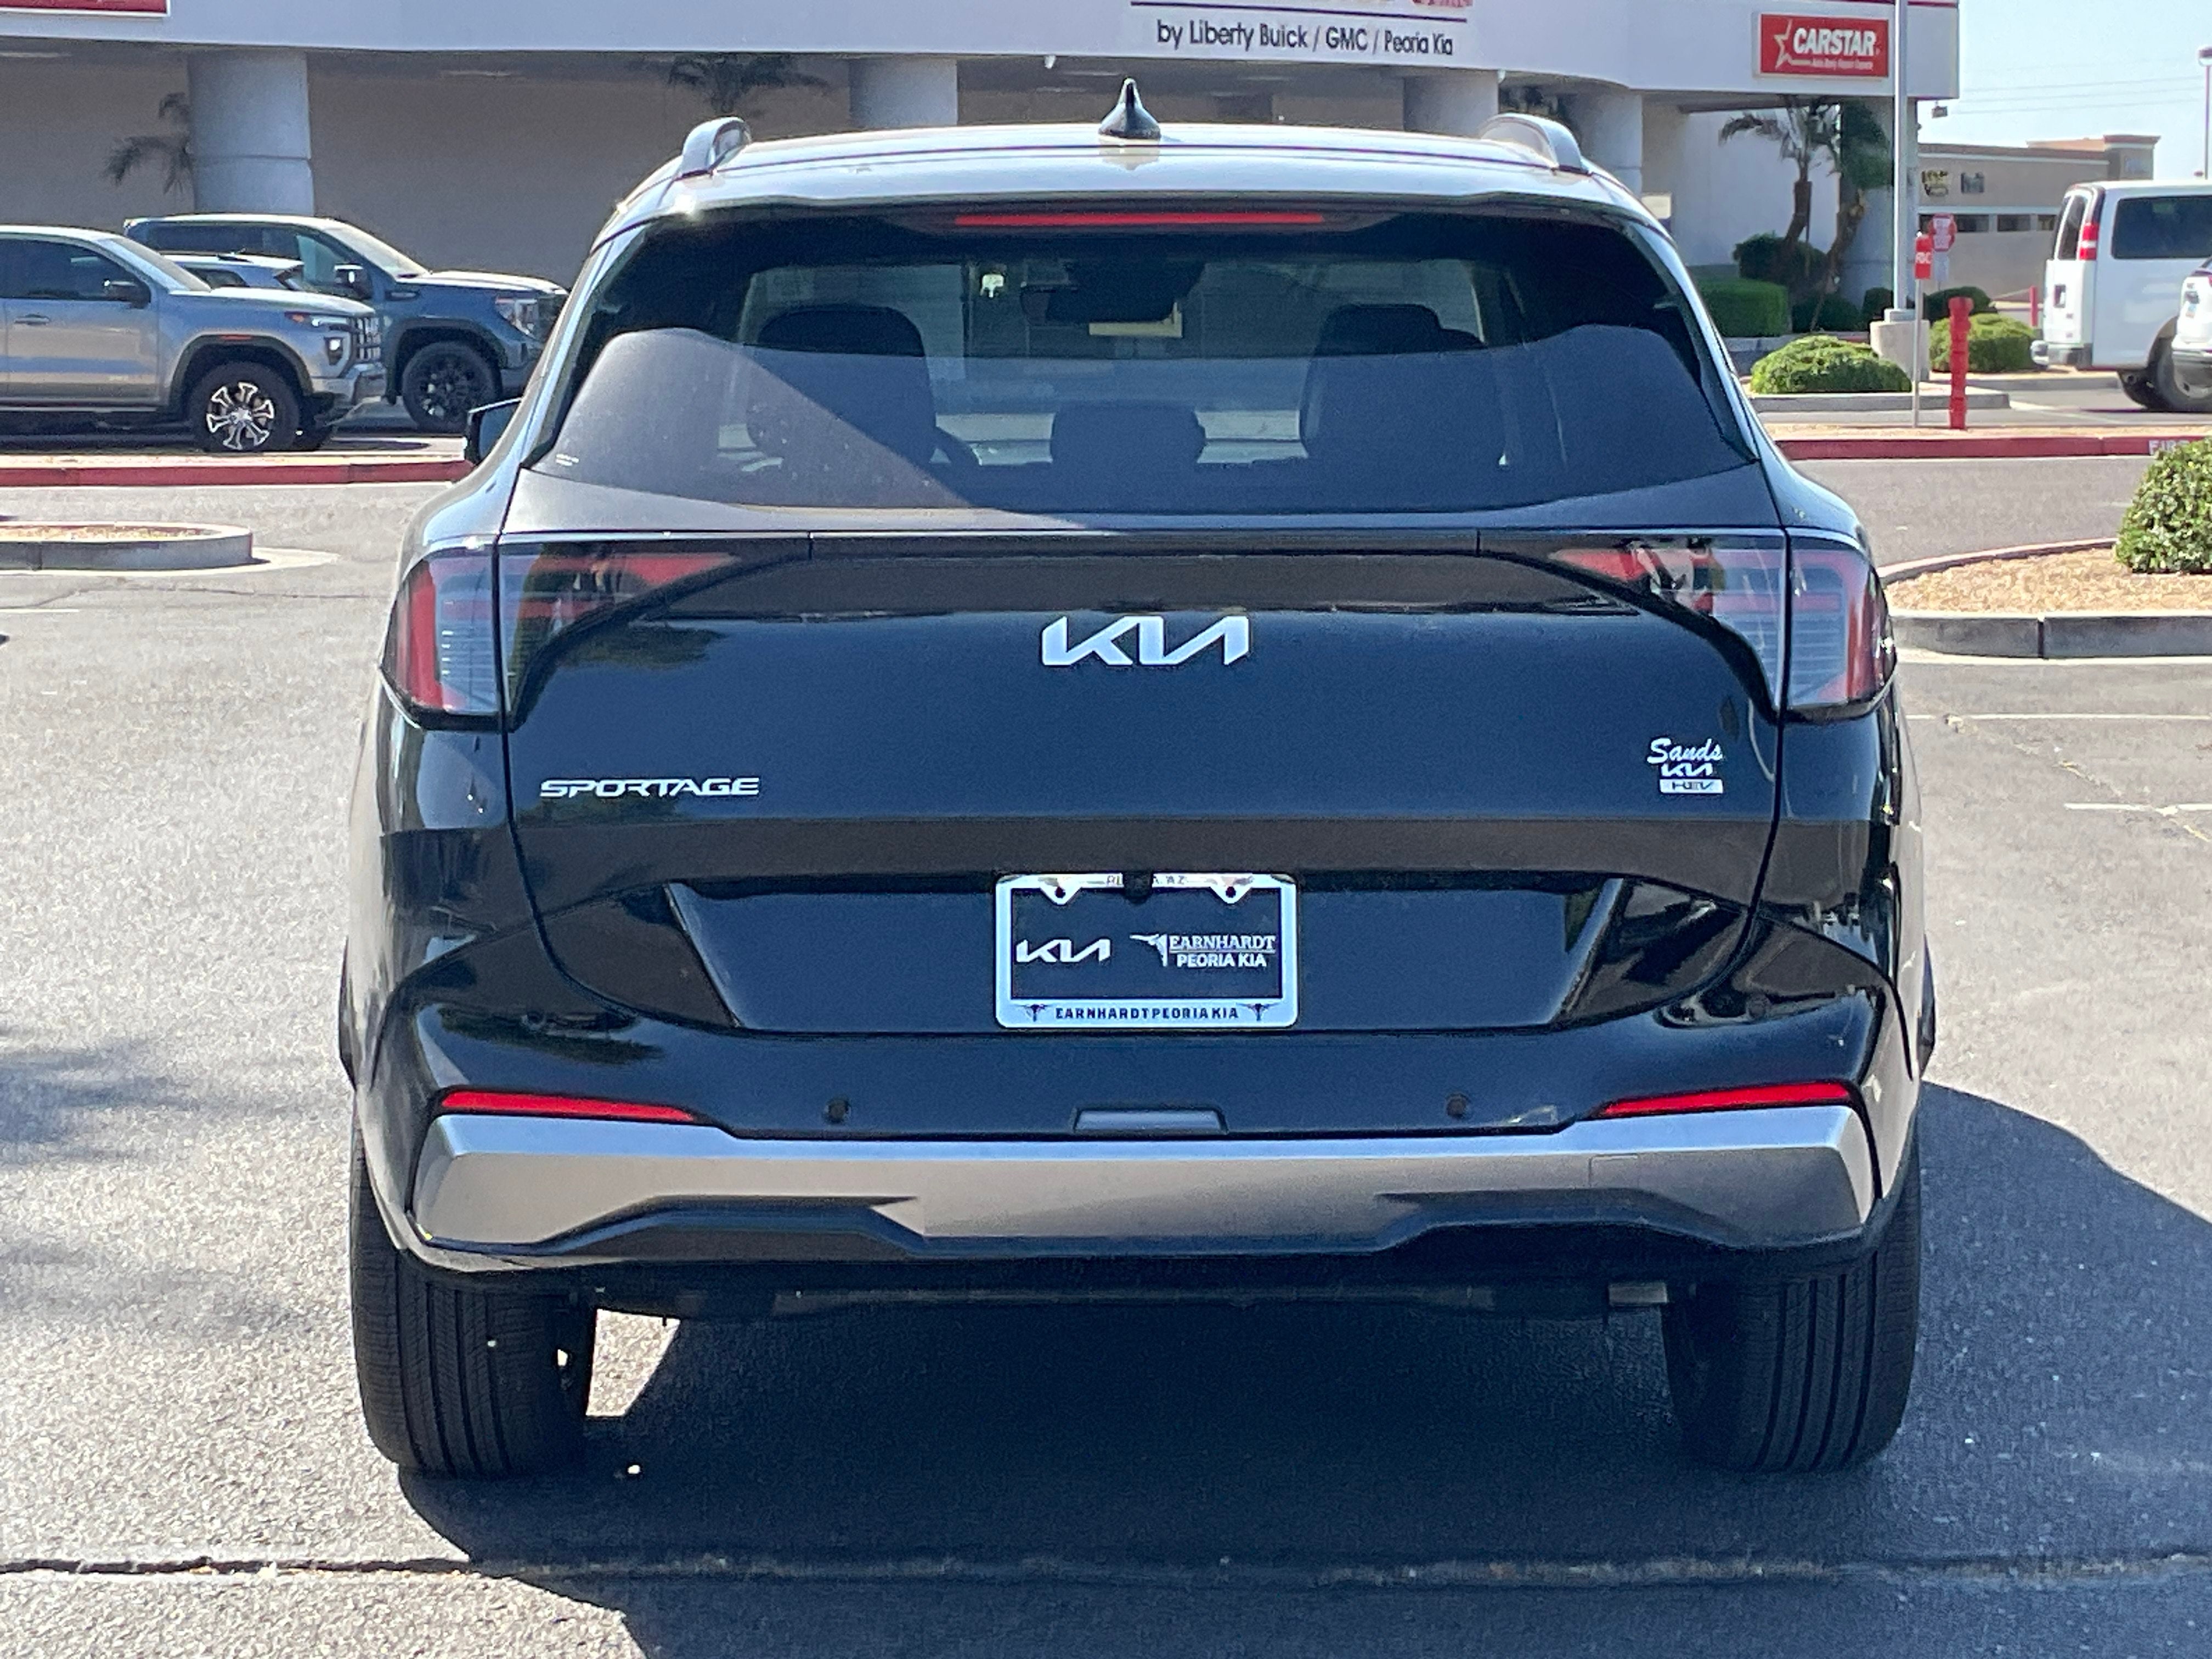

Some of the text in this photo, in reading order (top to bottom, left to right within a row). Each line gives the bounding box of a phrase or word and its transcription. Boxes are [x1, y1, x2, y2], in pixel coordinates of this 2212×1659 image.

[1157, 19, 1183, 50] by
[1189, 20, 1255, 52] Liberty
[1260, 23, 1308, 48] Buick
[1326, 26, 1368, 51] GMC
[1384, 30, 1429, 54] Peoria
[1432, 33, 1453, 55] Kia
[1793, 27, 1877, 55] CARSTAR
[1042, 616, 1249, 665] KIA
[1647, 737, 1723, 764] Sands
[540, 777, 759, 797] SPORTAGE
[1016, 939, 1111, 963] KIA
[1169, 935, 1276, 950] EARNHARDT
[1177, 953, 1267, 968] PEORIA KIA
